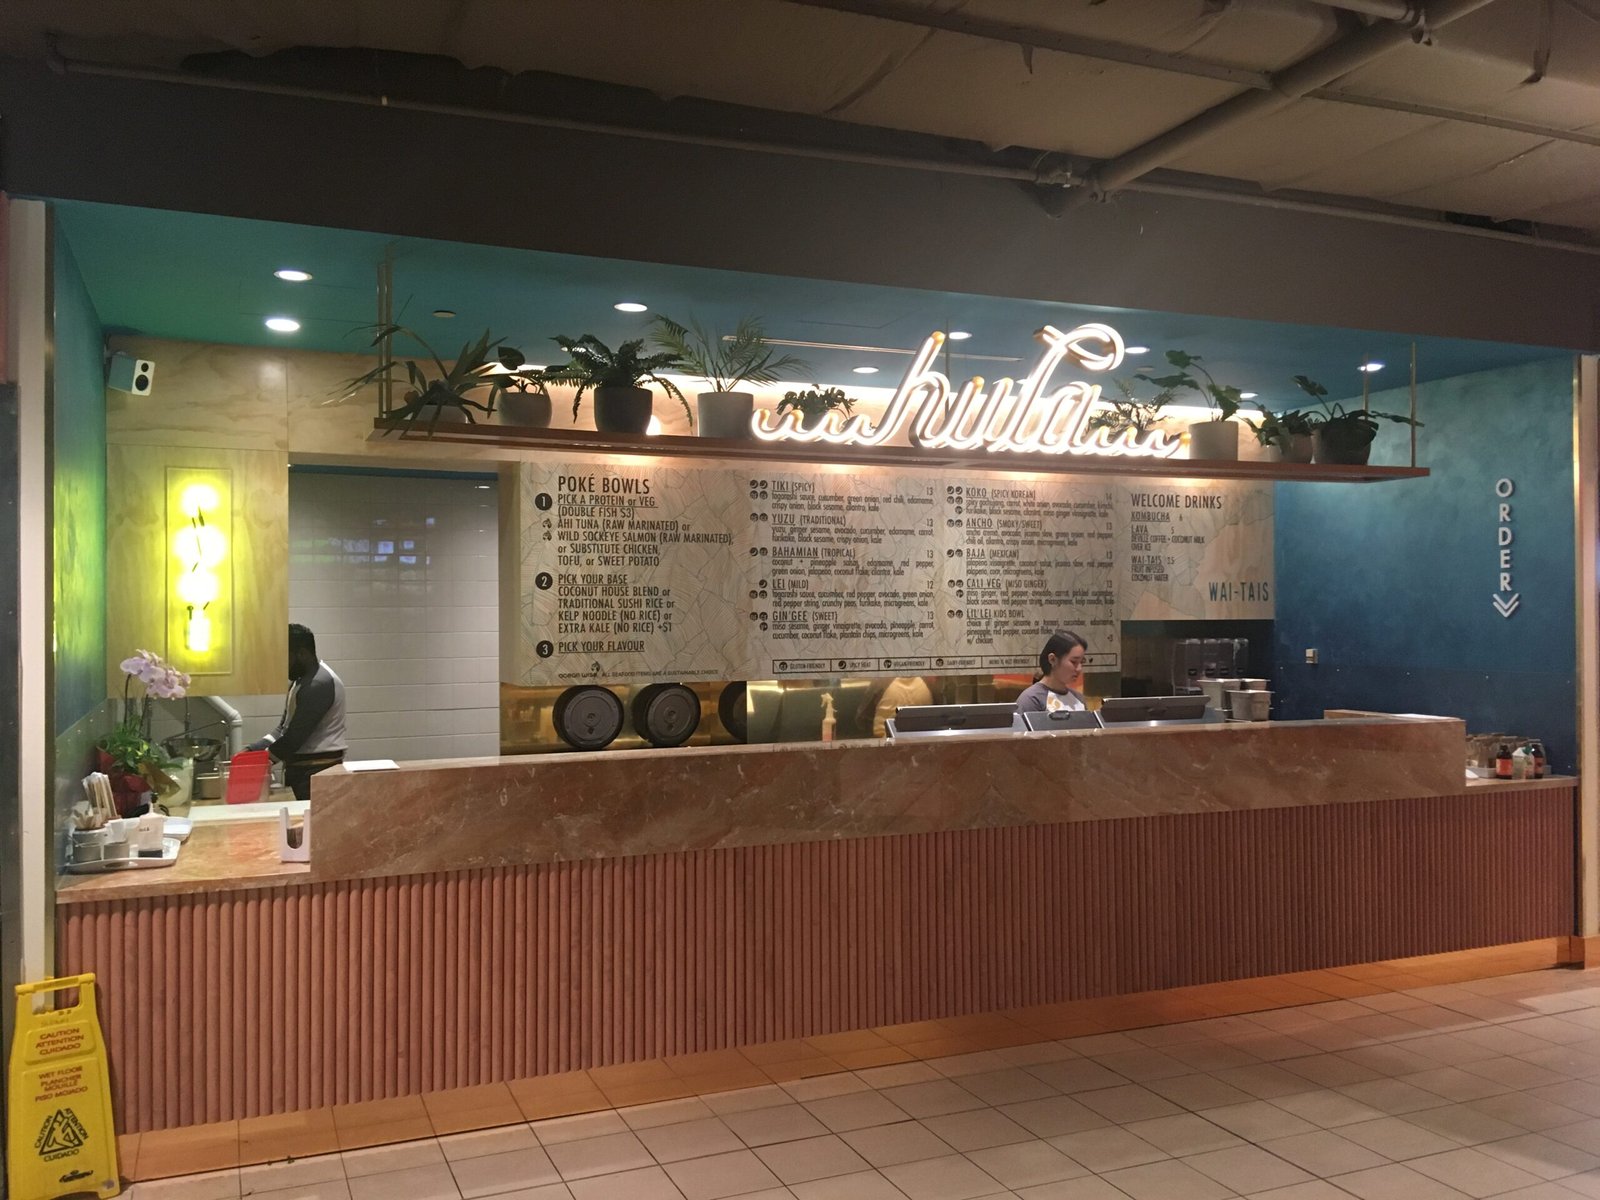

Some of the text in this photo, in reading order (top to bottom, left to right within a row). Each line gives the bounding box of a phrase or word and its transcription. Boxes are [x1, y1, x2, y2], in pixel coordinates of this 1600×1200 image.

[558, 474, 650, 494] POKÉ BOWLS
[772, 481, 789, 490] TIKI
[791, 482, 815, 493] (SPICY)
[966, 488, 987, 497] KOKO
[991, 489, 1009, 498] (SPICY
[1011, 490, 1036, 500] KOREAN)
[558, 494, 577, 505] PICK
[580, 494, 586, 505] A
[589, 495, 624, 506] PROTEIN
[628, 498, 636, 506] or
[639, 496, 655, 507] VEG
[1131, 494, 1222, 509] WELCOME DRINKS
[558, 506, 595, 519] (DOUBLE
[599, 507, 617, 517] FISH
[1131, 511, 1170, 521] KOMBUCHA
[558, 518, 691, 533] AHI TUNA (RAW MARINATED) or
[772, 514, 795, 524] YUZU
[800, 515, 846, 527] (TRADITIONAL)
[966, 518, 993, 527] ANCHO
[997, 519, 1042, 530] (SMOKY/SWEET)
[1131, 525, 1149, 534] LAVA
[1496, 478, 1512, 591] ORDER
[558, 531, 579, 541] WILD
[583, 531, 619, 542] SOCKEYE
[622, 532, 656, 542] SALMON
[659, 531, 680, 545] (RAW
[558, 545, 566, 553] or
[570, 544, 620, 554] SUBSTITUTE
[772, 547, 934, 559] BAHAMIAN (TROPICAL) 13
[966, 549, 985, 557] BAJA
[989, 550, 1019, 560] (MEXICAN)
[558, 555, 660, 567] TOFU, or SWEET POTATO
[1131, 555, 1162, 565] WAI-TAIS
[558, 574, 577, 584] PICK
[582, 574, 604, 584] YOUR
[607, 574, 628, 584] BASE
[772, 579, 934, 590] LEI (MILD) 12
[966, 578, 983, 588] CALI
[986, 578, 1001, 588] VEG
[1005, 579, 1022, 590] (MISO
[1024, 579, 1047, 589] GINGER)
[558, 586, 670, 596] COCONUT HOUSE BLEND or
[1208, 582, 1269, 601] WAI-TAIS
[558, 598, 675, 609] TRADITIONAL SUSHI RICE or
[558, 610, 672, 622] KELP NOODLE (NO RICE) or
[812, 611, 838, 622] (SWEET)
[927, 611, 934, 620] 13
[994, 609, 1007, 618] KIDS
[1008, 609, 1025, 618] BOWL
[558, 624, 586, 633] EXTRA
[589, 623, 610, 633] KALE
[613, 623, 630, 634] (NO
[632, 623, 654, 634] RICE)
[558, 641, 578, 652] PICK
[582, 641, 604, 651] YOUR
[607, 640, 645, 651] FLAVOUR
[40, 1028, 80, 1040] CAUTION
[35, 1034, 84, 1049] ATTENTION
[39, 1043, 81, 1056] CUIDADO
[38, 1066, 83, 1079] WET FLOOR
[35, 1086, 88, 1102] PISO MOJADO
[64, 1107, 89, 1140] ATTENTION
[34, 1115, 53, 1148] CAUTION
[44, 1148, 80, 1162] CUIDADO
